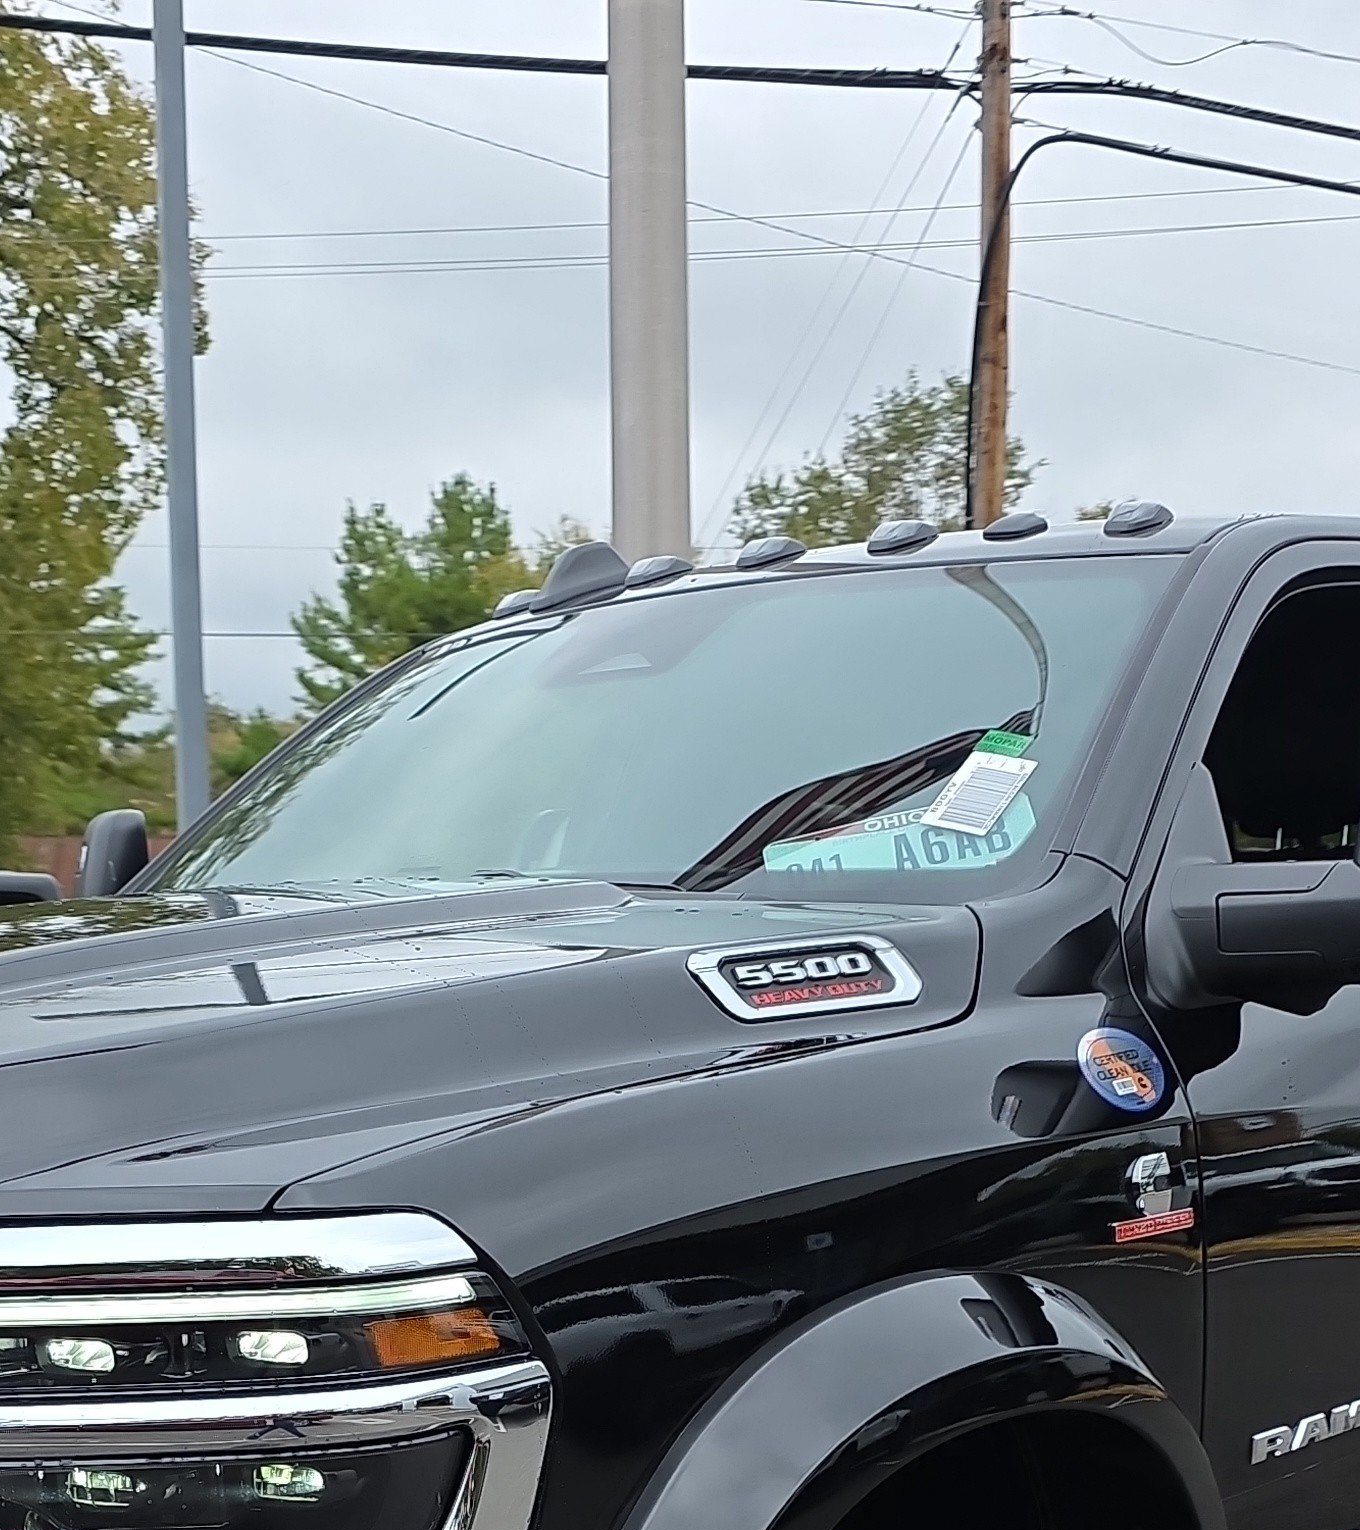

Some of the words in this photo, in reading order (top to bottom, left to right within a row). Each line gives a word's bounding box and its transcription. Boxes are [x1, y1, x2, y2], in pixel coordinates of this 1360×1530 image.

[863, 811, 925, 832] OHIO
[733, 952, 872, 988] 5500
[750, 984, 824, 1005] HEAVY
[826, 979, 884, 996] DUTY
